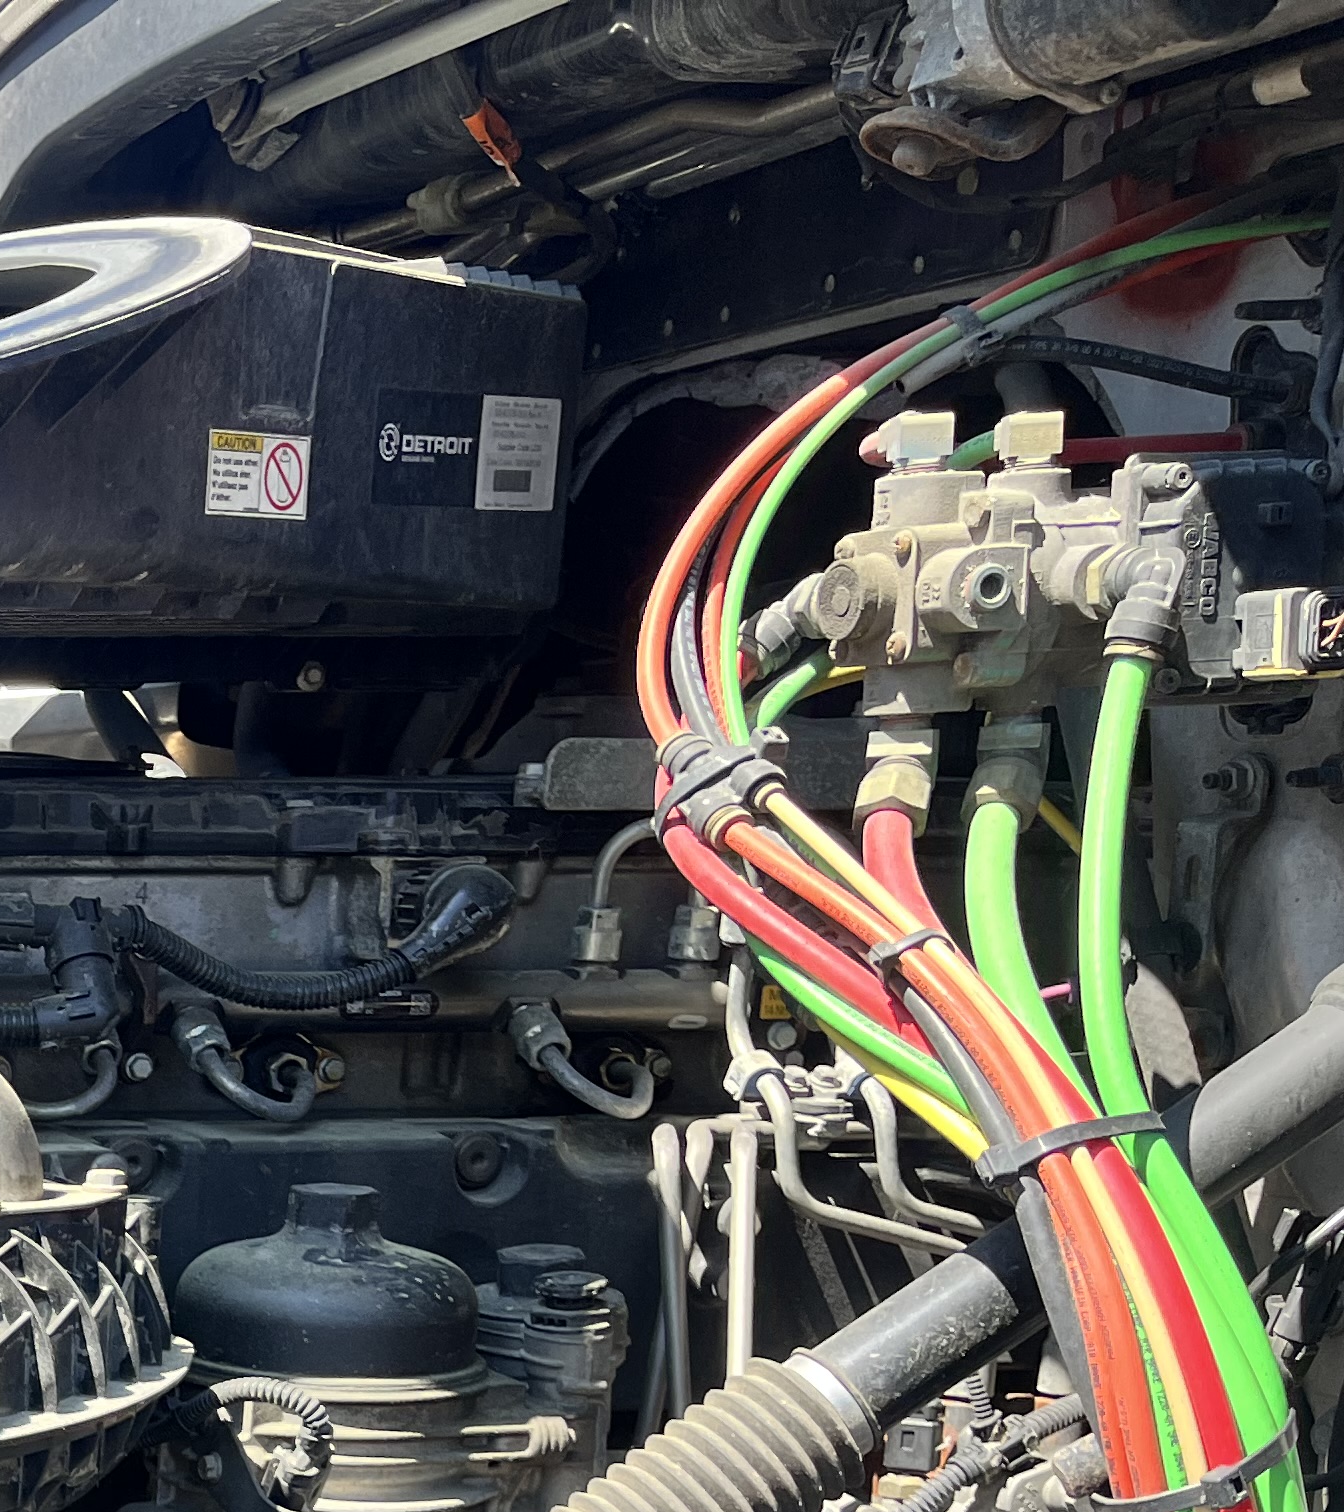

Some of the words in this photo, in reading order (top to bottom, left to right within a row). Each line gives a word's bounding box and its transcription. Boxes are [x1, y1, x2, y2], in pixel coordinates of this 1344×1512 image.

[217, 435, 257, 450] CAUTION
[401, 434, 473, 455] DETROIT
[1199, 512, 1219, 616] WABCO
